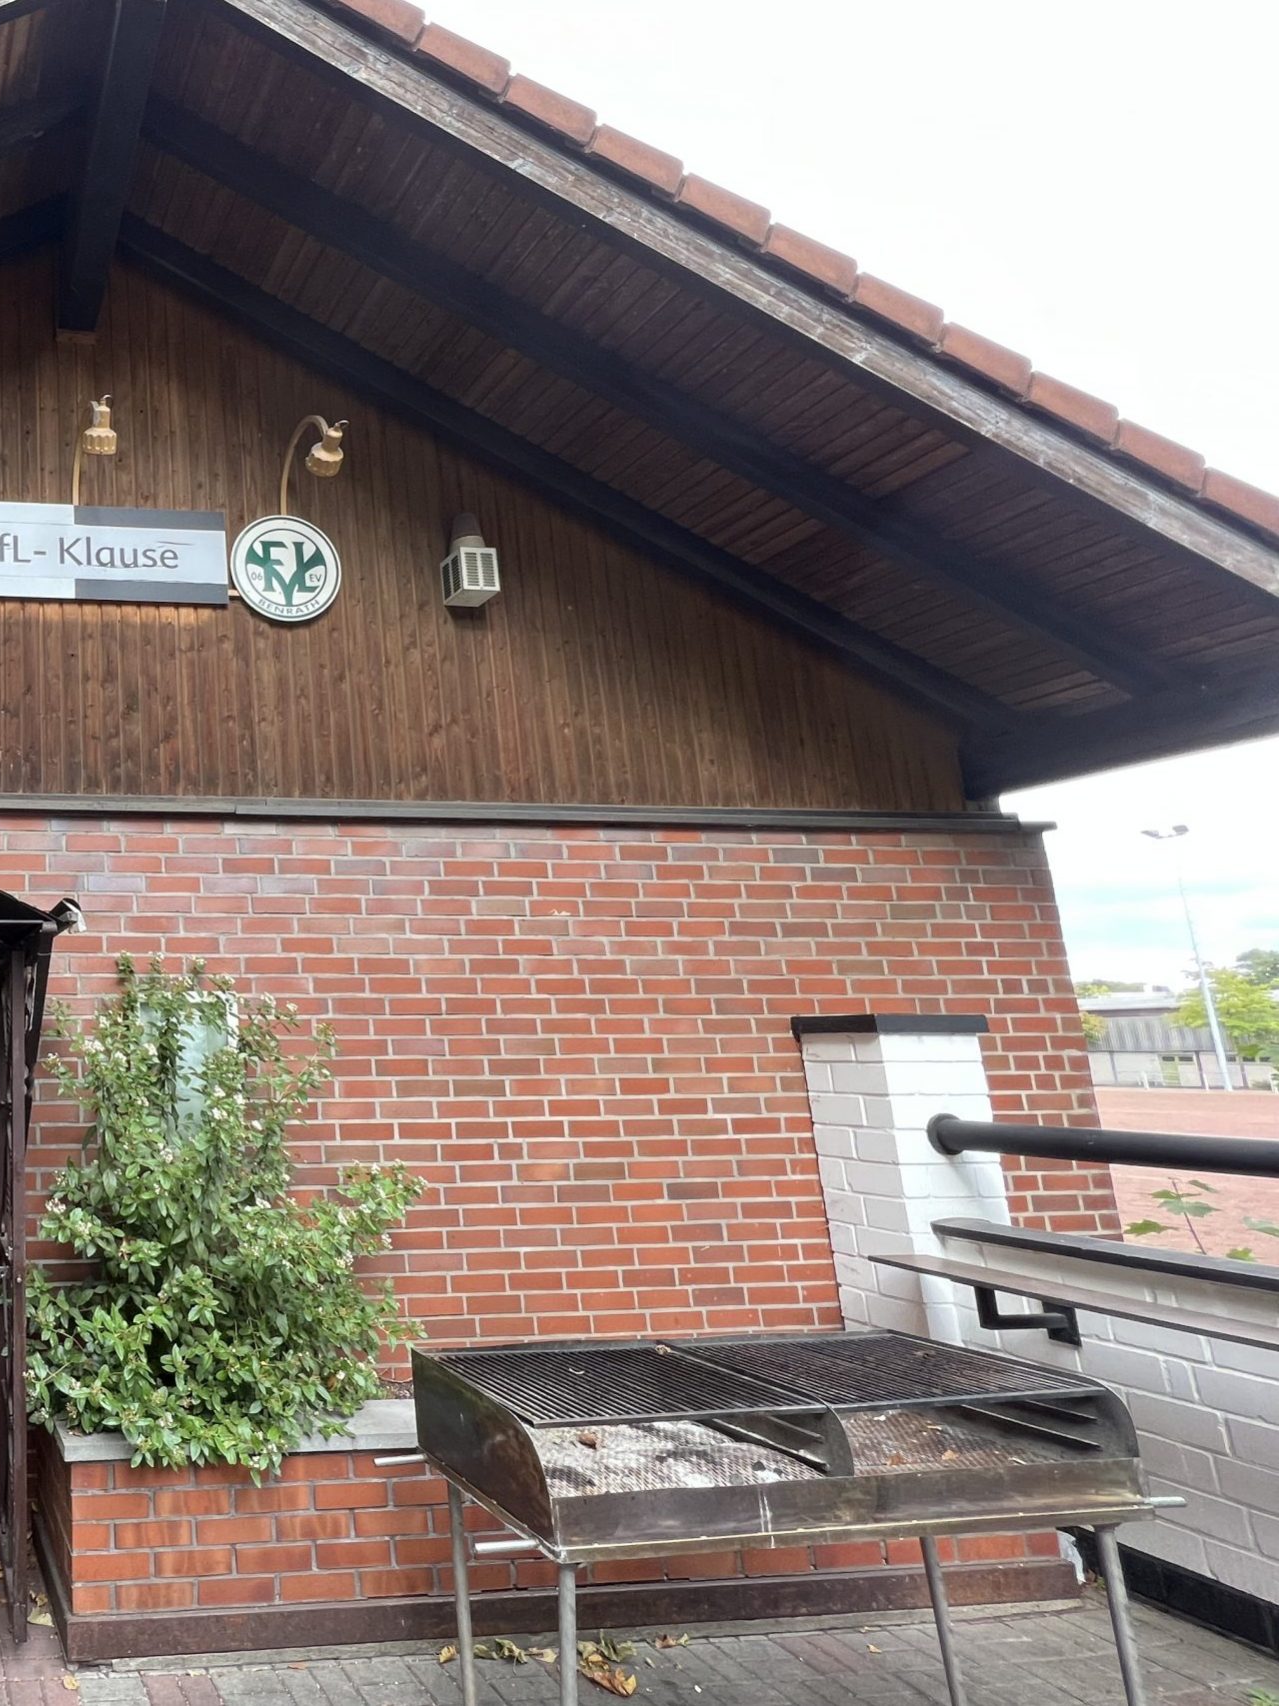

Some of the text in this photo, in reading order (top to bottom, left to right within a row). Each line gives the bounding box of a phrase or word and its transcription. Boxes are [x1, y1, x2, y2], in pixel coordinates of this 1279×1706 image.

[58, 536, 180, 569] Klause
[250, 571, 263, 581] 06
[308, 573, 322, 583] EV
[257, 598, 321, 616] BENRATH
